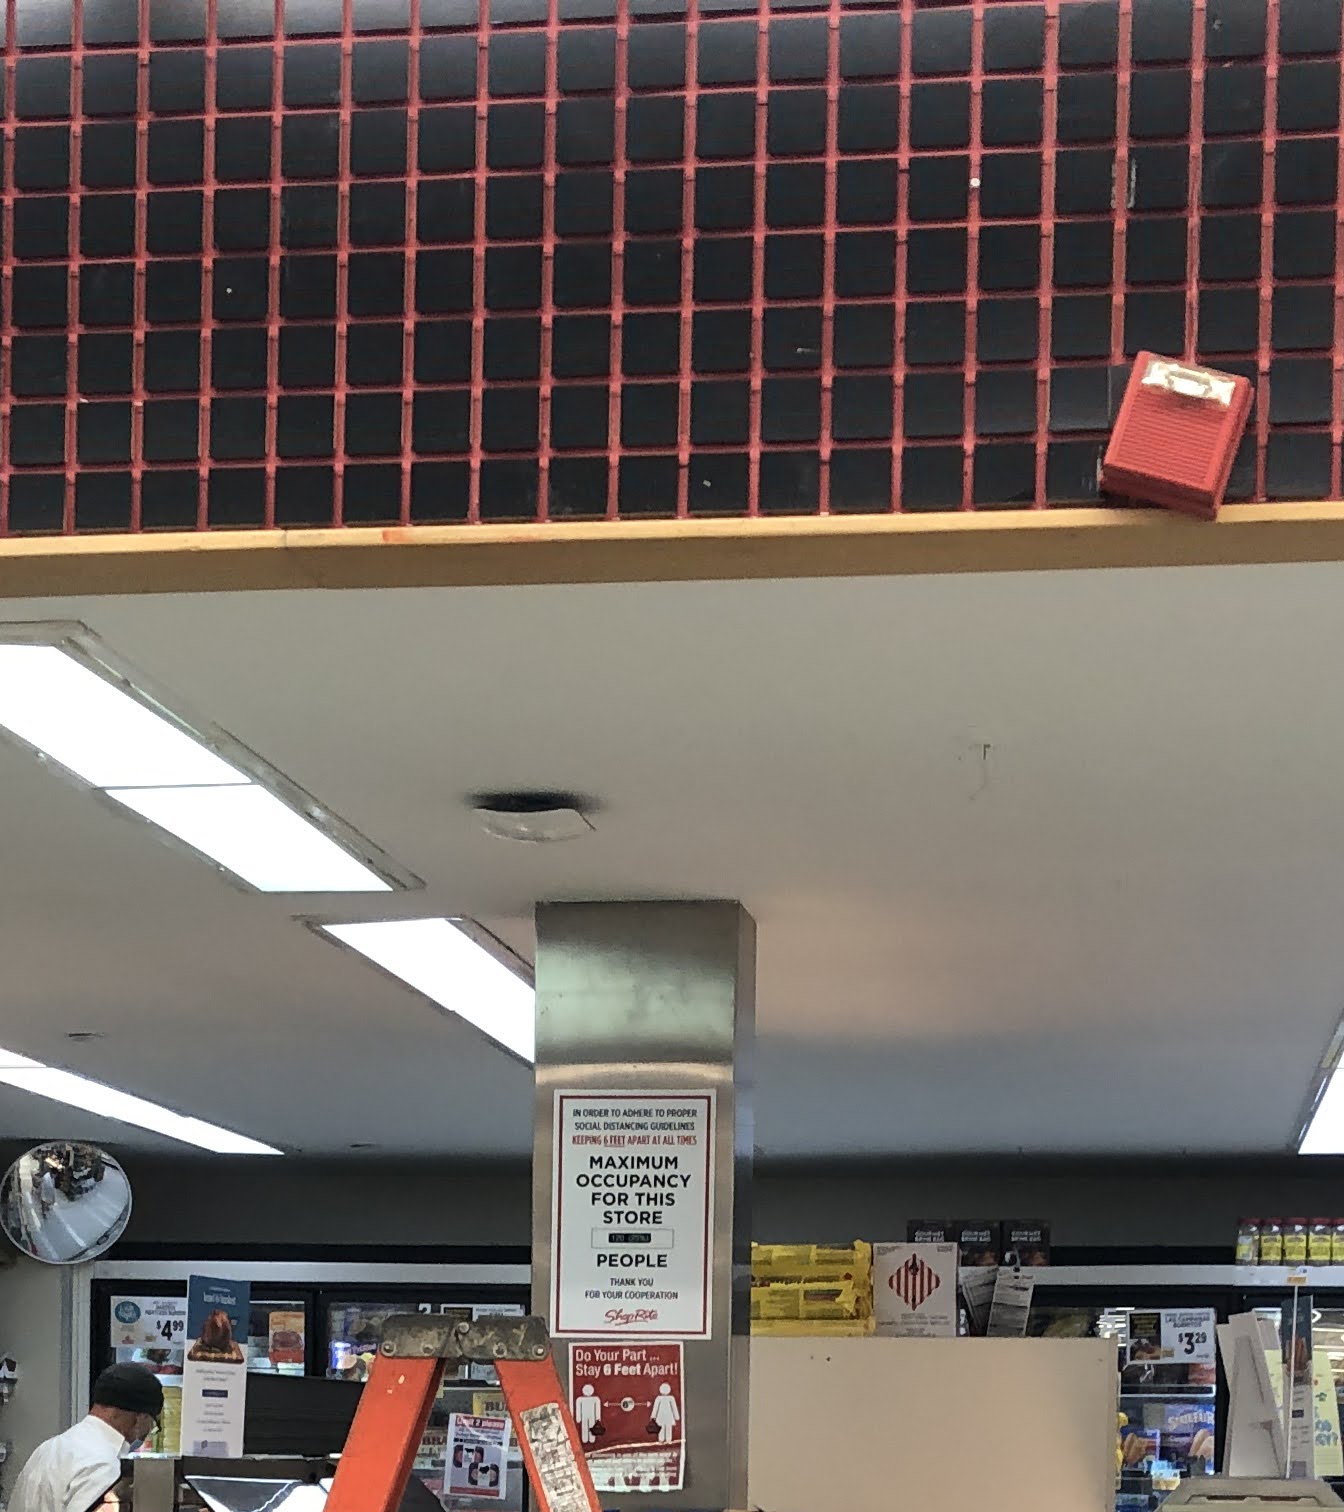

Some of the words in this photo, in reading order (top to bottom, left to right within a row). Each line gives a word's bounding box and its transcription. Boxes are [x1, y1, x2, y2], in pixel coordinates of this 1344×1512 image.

[573, 1109, 580, 1117] IN
[583, 1109, 608, 1117] ORDER
[611, 1109, 620, 1117] TO
[623, 1109, 653, 1117] ADHERE
[656, 1109, 664, 1117] TO
[667, 1109, 697, 1117] PROPER
[575, 1122, 601, 1130] SOCIAL
[604, 1122, 648, 1130] DISTANCING
[650, 1122, 695, 1130] GUIDELINES
[572, 1135, 601, 1145] KEEPING
[604, 1136, 608, 1145] 6
[610, 1136, 625, 1145] FEET
[628, 1136, 650, 1145] APART
[652, 1136, 660, 1145] AT
[663, 1136, 675, 1145] ALL
[677, 1136, 697, 1145] TIMES
[590, 1156, 678, 1169] MAXIMUM
[576, 1174, 691, 1188] OCCUPANCY
[592, 1193, 628, 1206] FOR
[635, 1193, 675, 1206] THIS
[603, 1211, 662, 1224] STORE
[597, 1254, 668, 1267] PEOPLE
[610, 1278, 636, 1286] THANK
[638, 1278, 654, 1286] YOU
[585, 1290, 600, 1298] FOR
[602, 1291, 623, 1299] YOUR
[625, 1291, 678, 1299] COOPERATION
[575, 1350, 591, 1361] Do
[594, 1350, 619, 1361] Your
[622, 1350, 646, 1361] Part
[575, 1363, 600, 1377] Stay
[604, 1364, 611, 1376] 6
[614, 1363, 641, 1376] Feet
[643, 1363, 678, 1377] Apart!
